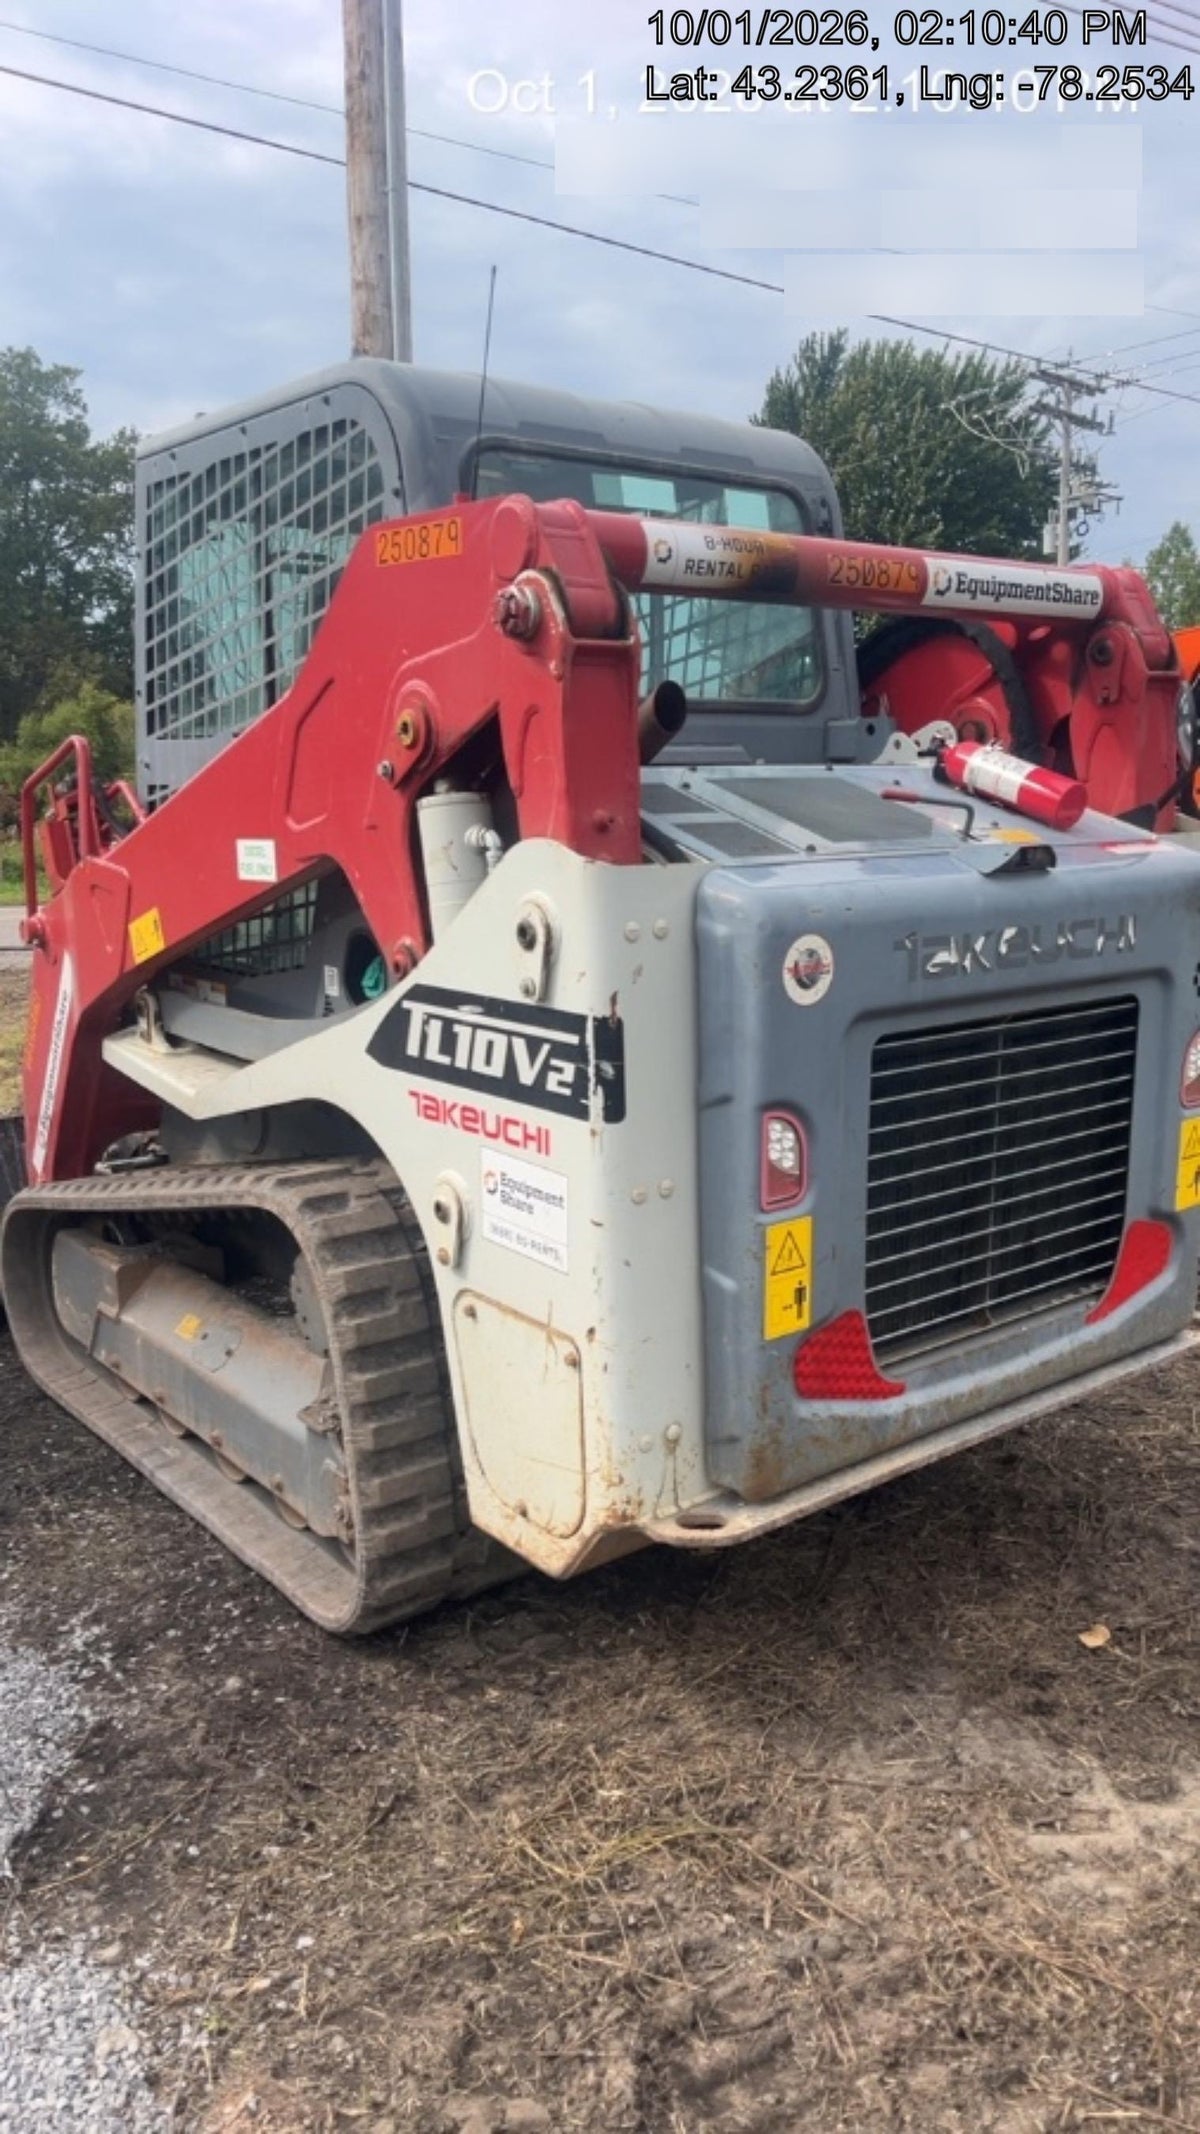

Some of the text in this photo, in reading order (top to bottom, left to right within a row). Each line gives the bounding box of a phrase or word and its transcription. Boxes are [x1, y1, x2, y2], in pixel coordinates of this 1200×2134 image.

[379, 519, 459, 565] 250879
[684, 558, 744, 579] RENTAL
[829, 554, 919, 588] 250879
[955, 571, 1100, 606] EquipmentShare
[408, 1090, 551, 1157] TAKEUCHI
